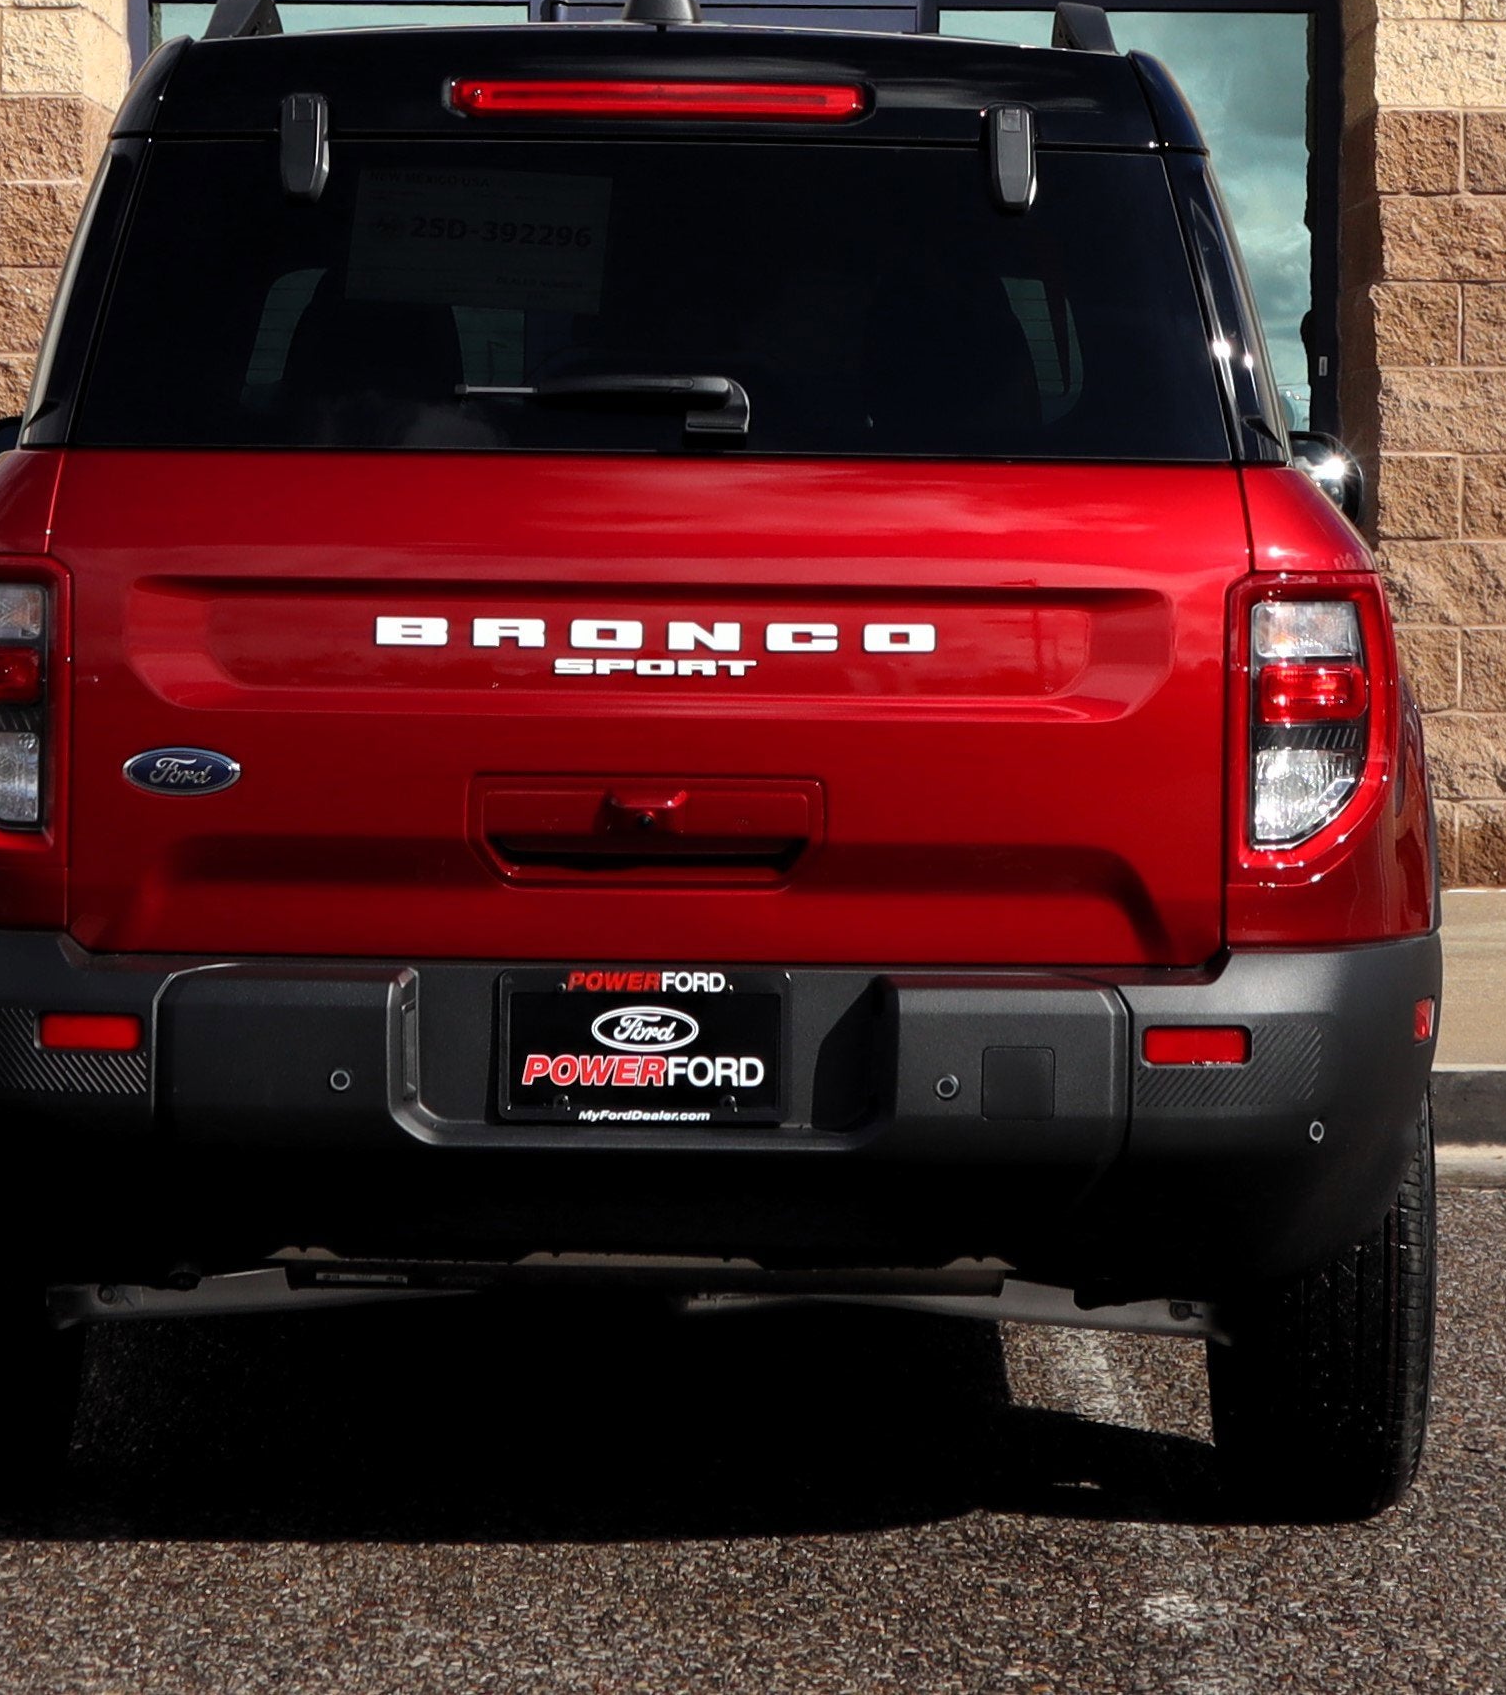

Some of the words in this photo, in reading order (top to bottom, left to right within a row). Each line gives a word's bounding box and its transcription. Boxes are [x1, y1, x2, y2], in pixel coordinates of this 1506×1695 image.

[375, 616, 936, 653] BRONCO
[553, 658, 758, 677] SPORT
[149, 757, 212, 784] Ford
[613, 1014, 676, 1042] Ford
[578, 1109, 711, 1123] MyFordDealer.com
